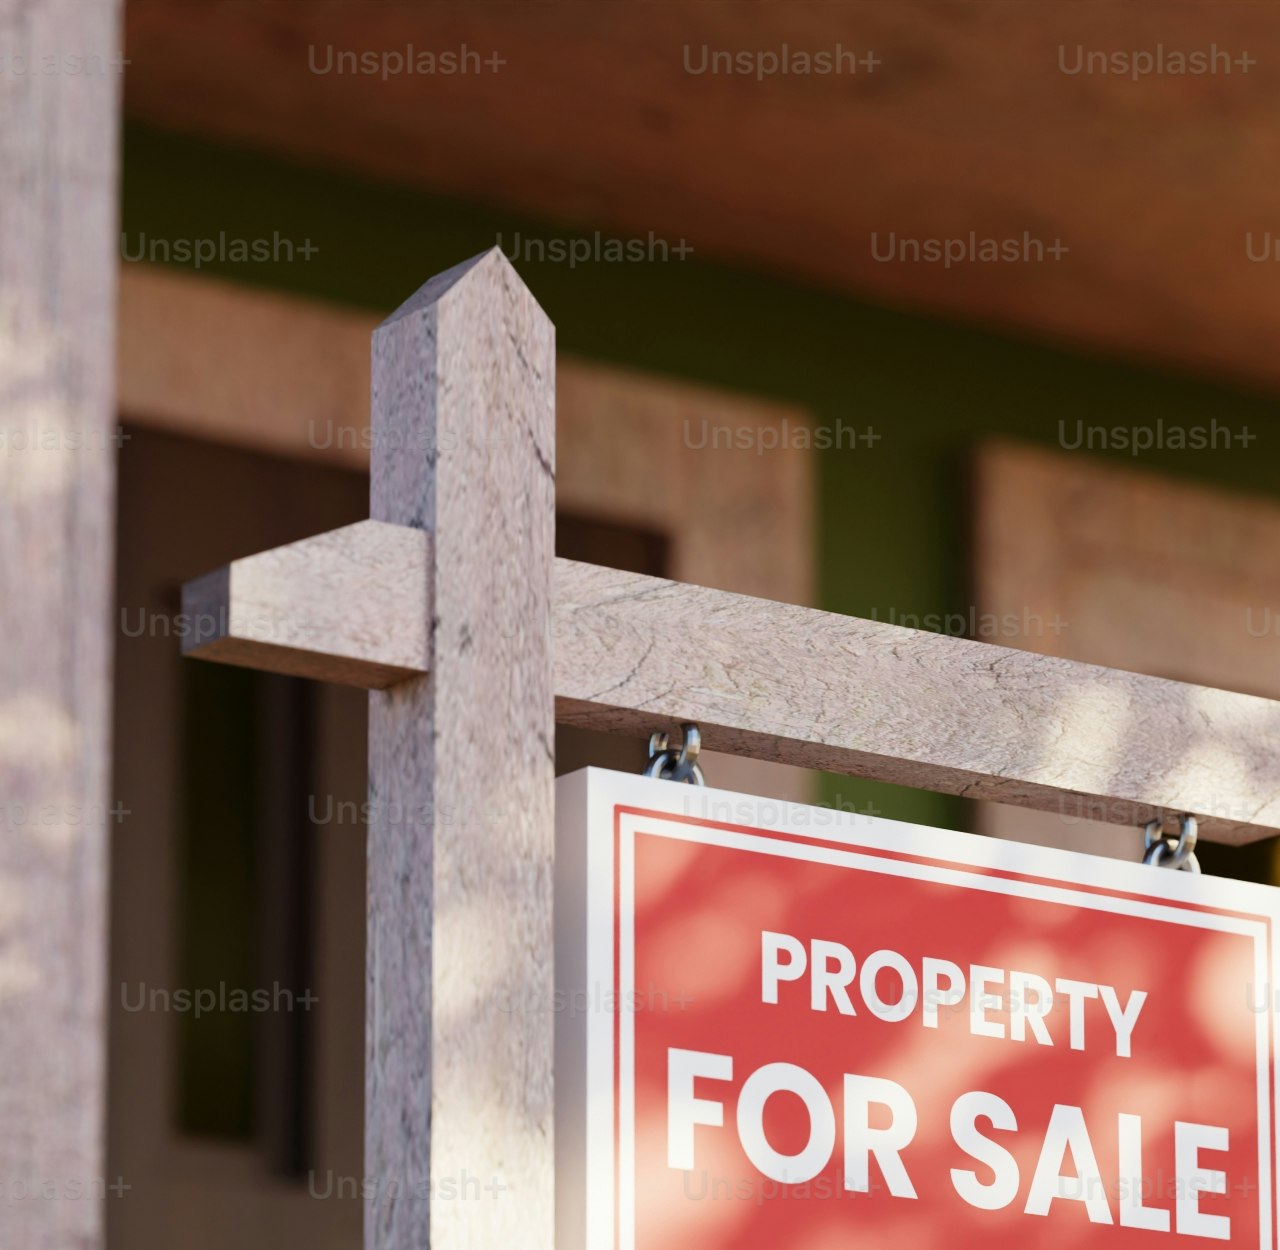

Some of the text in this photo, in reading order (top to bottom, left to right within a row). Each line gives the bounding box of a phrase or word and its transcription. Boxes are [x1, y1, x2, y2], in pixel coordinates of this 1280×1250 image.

[761, 930, 1148, 1058] PROPERTY
[666, 1046, 1231, 1240] FOR SALE
